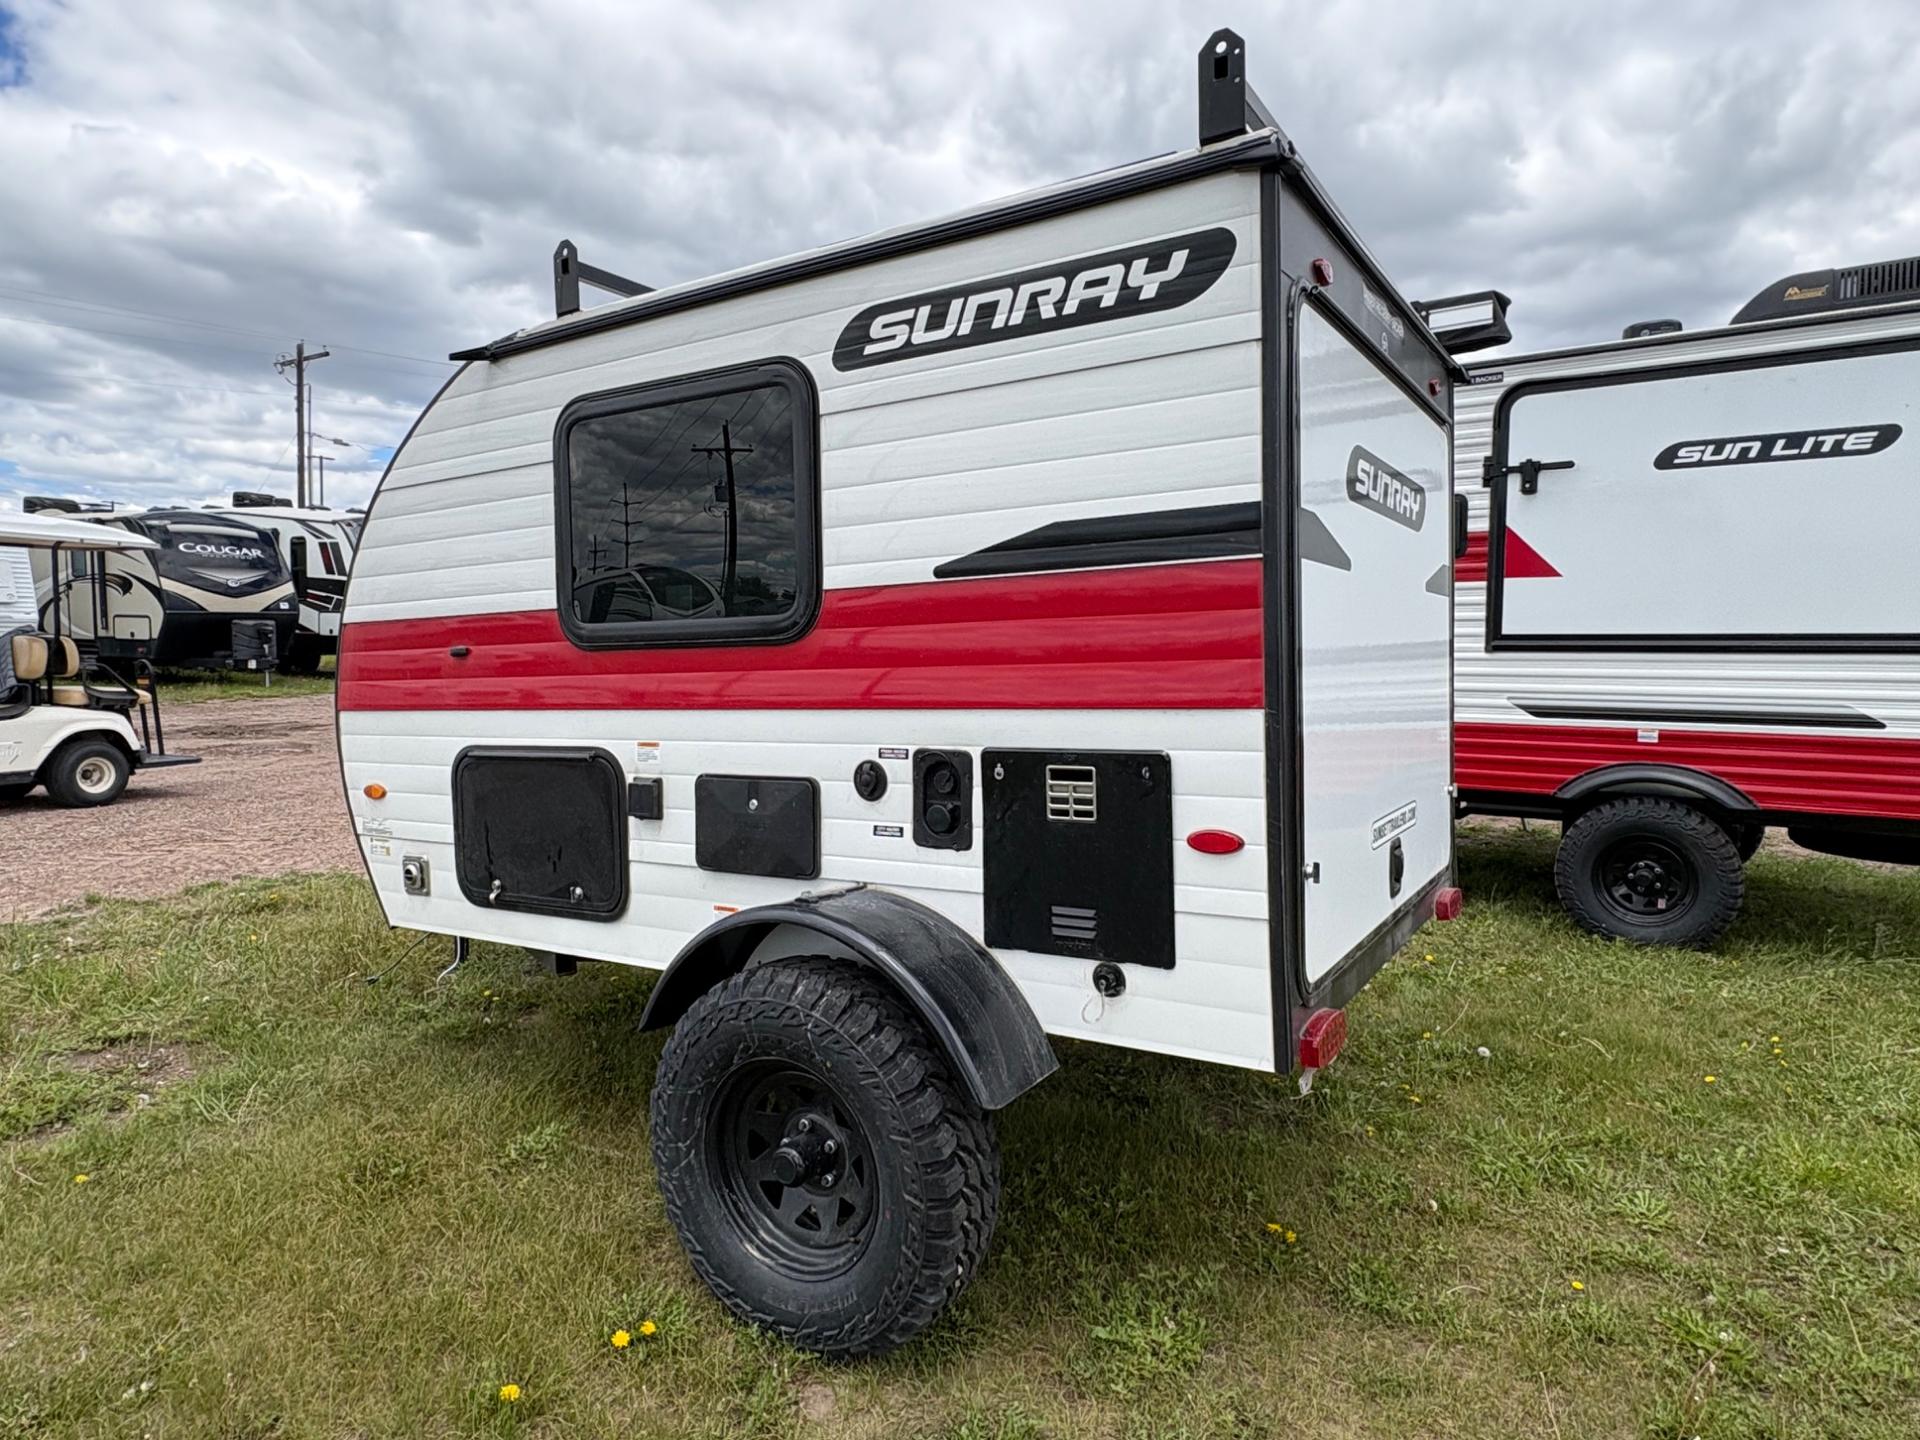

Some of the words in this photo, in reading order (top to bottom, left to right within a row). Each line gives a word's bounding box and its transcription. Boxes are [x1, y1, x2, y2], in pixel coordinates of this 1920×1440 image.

[863, 248, 1190, 356] SUNRAY
[1672, 441, 1762, 464] SUN
[1770, 431, 1879, 456] LITE
[1355, 458, 1420, 521] SUNRAY
[178, 542, 265, 558] COUGAR
